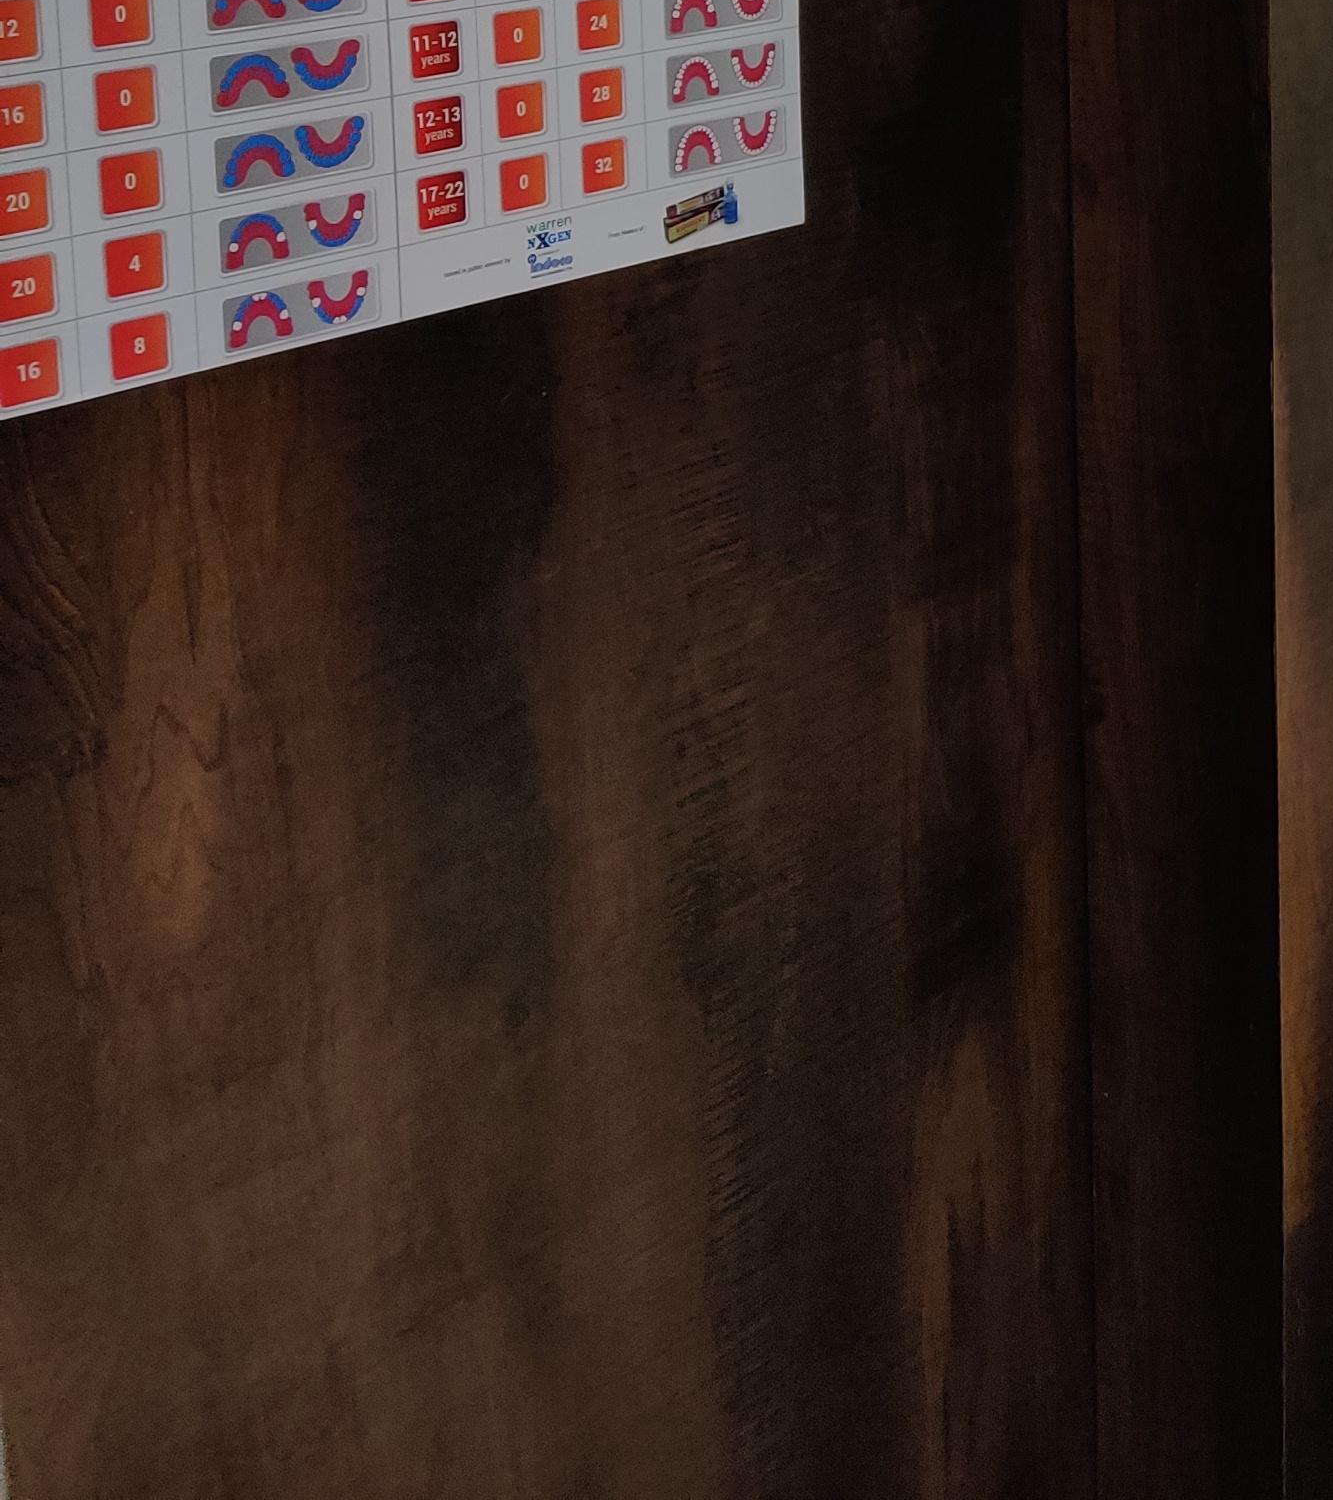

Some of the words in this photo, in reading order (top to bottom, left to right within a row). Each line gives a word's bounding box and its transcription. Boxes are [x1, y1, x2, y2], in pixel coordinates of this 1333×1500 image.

[115, 4, 127, 23] 0
[0, 19, 19, 38] 12
[589, 15, 609, 31] 24
[412, 31, 458, 51] 11-12
[513, 28, 523, 43] 0
[420, 51, 451, 67] years
[119, 88, 131, 106] 0
[592, 86, 611, 102] 28
[2, 107, 25, 126] 16
[416, 107, 461, 127] 12-13
[516, 102, 526, 117] 0
[424, 126, 455, 142] years
[594, 157, 613, 173] 32
[124, 172, 136, 190] 0
[519, 175, 529, 190] 0
[419, 181, 465, 203] 17-22
[6, 192, 30, 211] 20
[427, 201, 458, 217] years
[527, 216, 572, 233] warren
[527, 229, 572, 250] NXGEN
[128, 254, 141, 272] 4
[11, 277, 36, 297] 20
[133, 336, 146, 354] 8
[17, 362, 41, 381] 16
